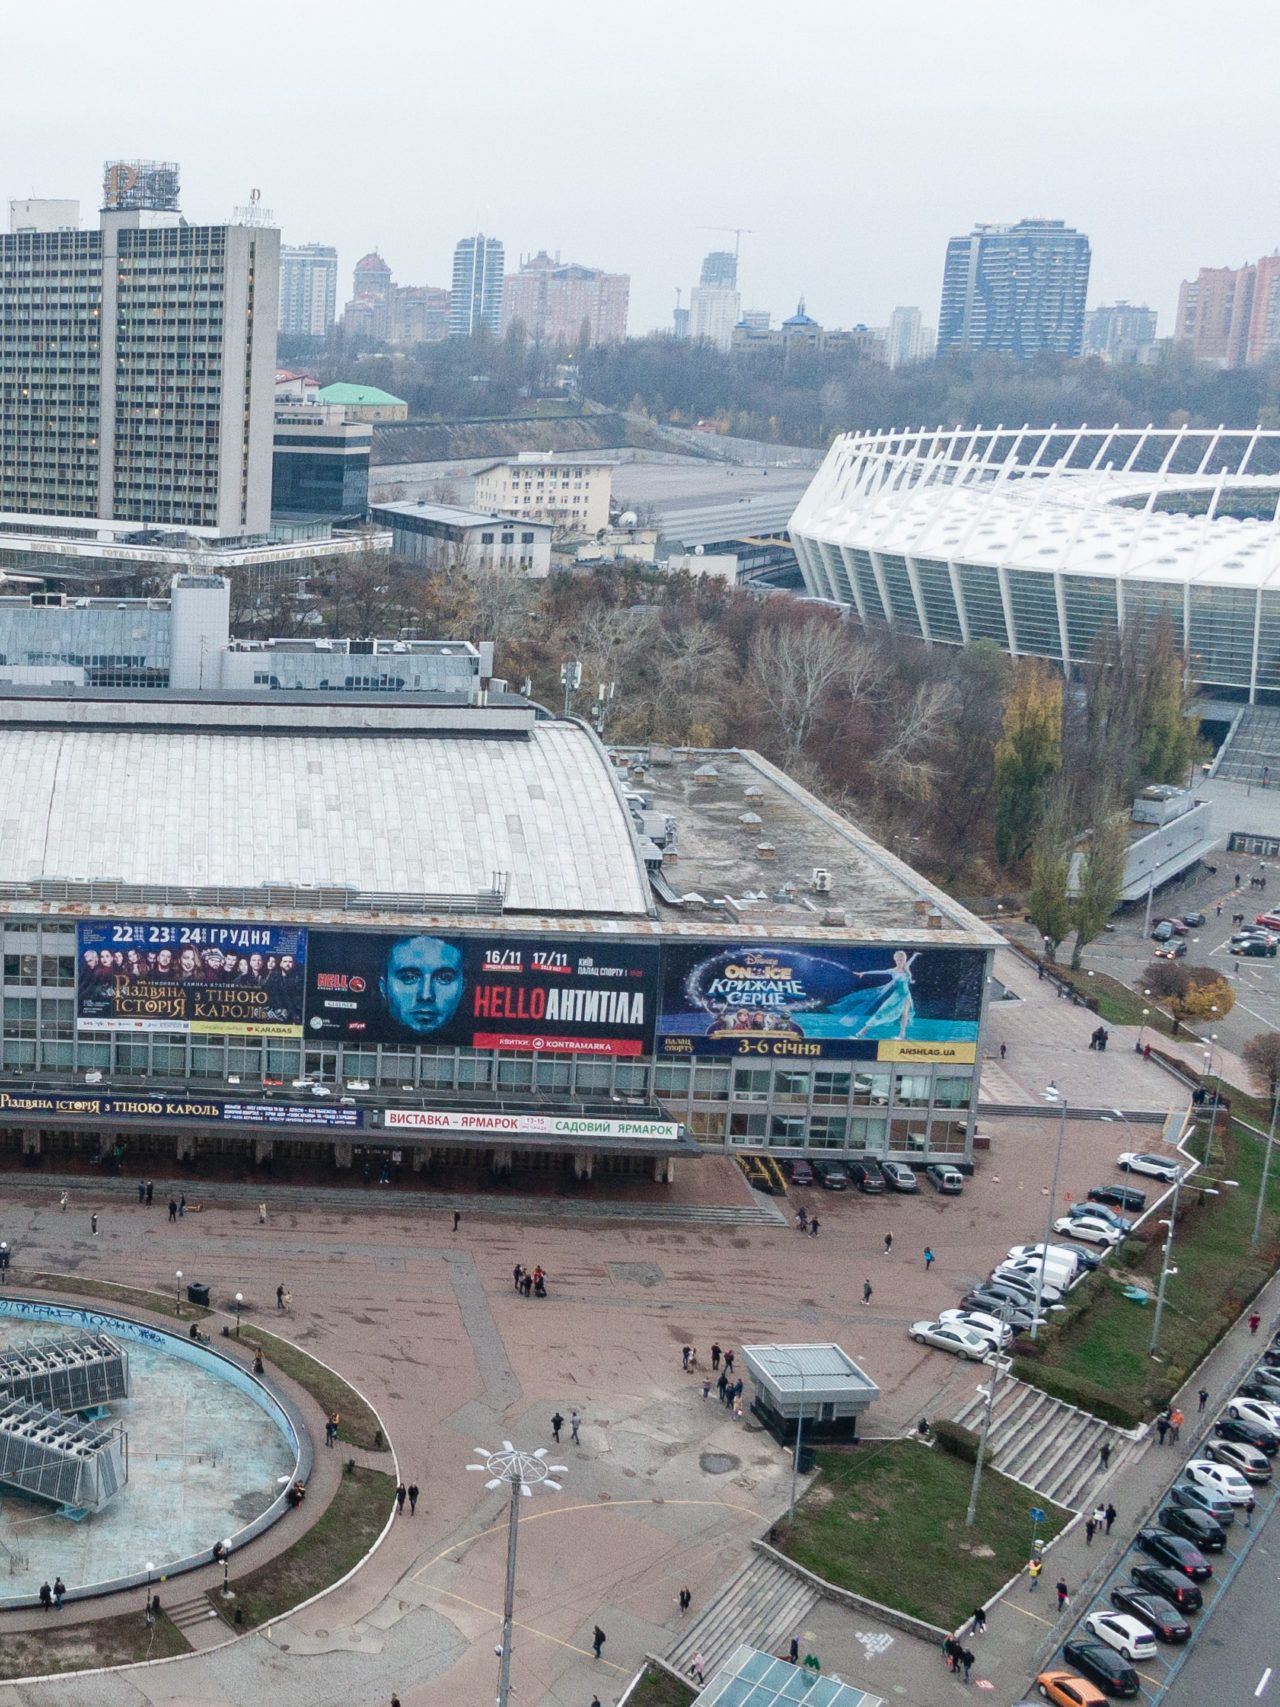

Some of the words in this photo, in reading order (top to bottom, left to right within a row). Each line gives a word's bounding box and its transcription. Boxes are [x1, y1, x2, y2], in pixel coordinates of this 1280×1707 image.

[112, 925, 133, 942] 22
[149, 926, 170, 943] 23
[180, 927, 202, 944] 24
[210, 928, 271, 947] ГРУДНЯ
[485, 949, 521, 965] 16/11
[533, 950, 567, 966] 17/11
[578, 966, 599, 976] ПАЛАЦ
[600, 967, 624, 976] СПОРТУ
[724, 964, 752, 979] ON
[764, 967, 793, 980] ICE
[317, 973, 348, 988] HELL
[707, 978, 807, 996] КРИЖАНЕ
[206, 989, 268, 1004] ТІНОЮ
[474, 984, 545, 1019] HELLO
[545, 987, 644, 1025] АНТИТІЛА
[726, 991, 786, 1006] СЕРЦЕ
[116, 999, 187, 1017] ІСТОРІЯ
[545, 1041, 612, 1051] KONTRAMARKA
[738, 1039, 769, 1054] 3-6
[773, 1039, 821, 1056] січня
[899, 1048, 956, 1056] ANSHLAG.UA
[56, 1100, 101, 1114] ІСТОРІЯ
[113, 1101, 163, 1114] ТІНОЮ
[166, 1103, 220, 1116] КАРОЛЬ
[389, 1113, 450, 1126] ВИСТАВКА
[461, 1116, 518, 1129] ЯРМАРОК
[555, 1120, 611, 1133] САДОВИЙ
[618, 1122, 673, 1135] ЯРМАРОК
